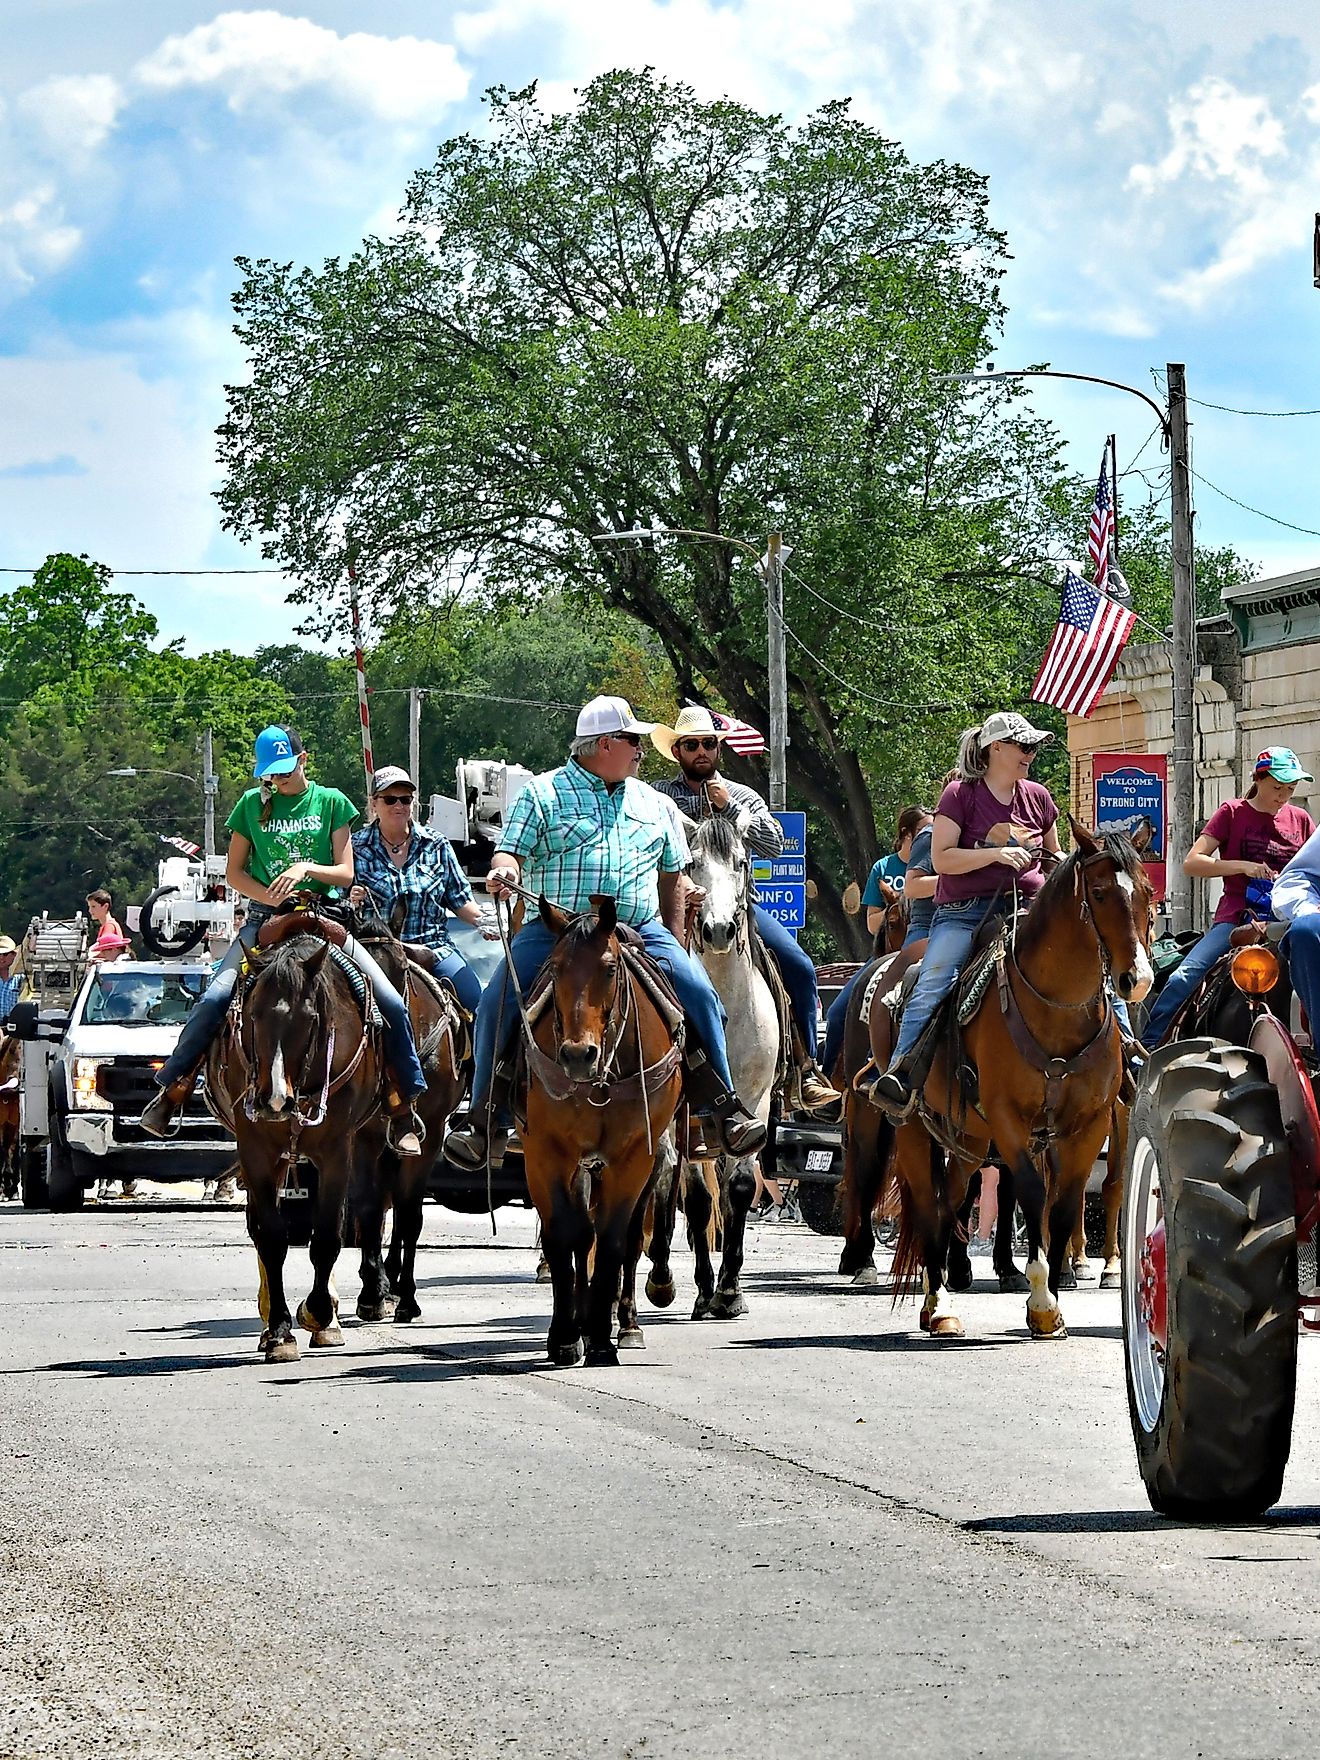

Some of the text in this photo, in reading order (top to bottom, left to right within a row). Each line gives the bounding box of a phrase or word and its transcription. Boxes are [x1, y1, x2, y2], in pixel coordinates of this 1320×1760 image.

[1107, 778, 1153, 786] WELCOME
[1100, 797, 1159, 807] STRONG CITY
[766, 908, 799, 922] OSK
